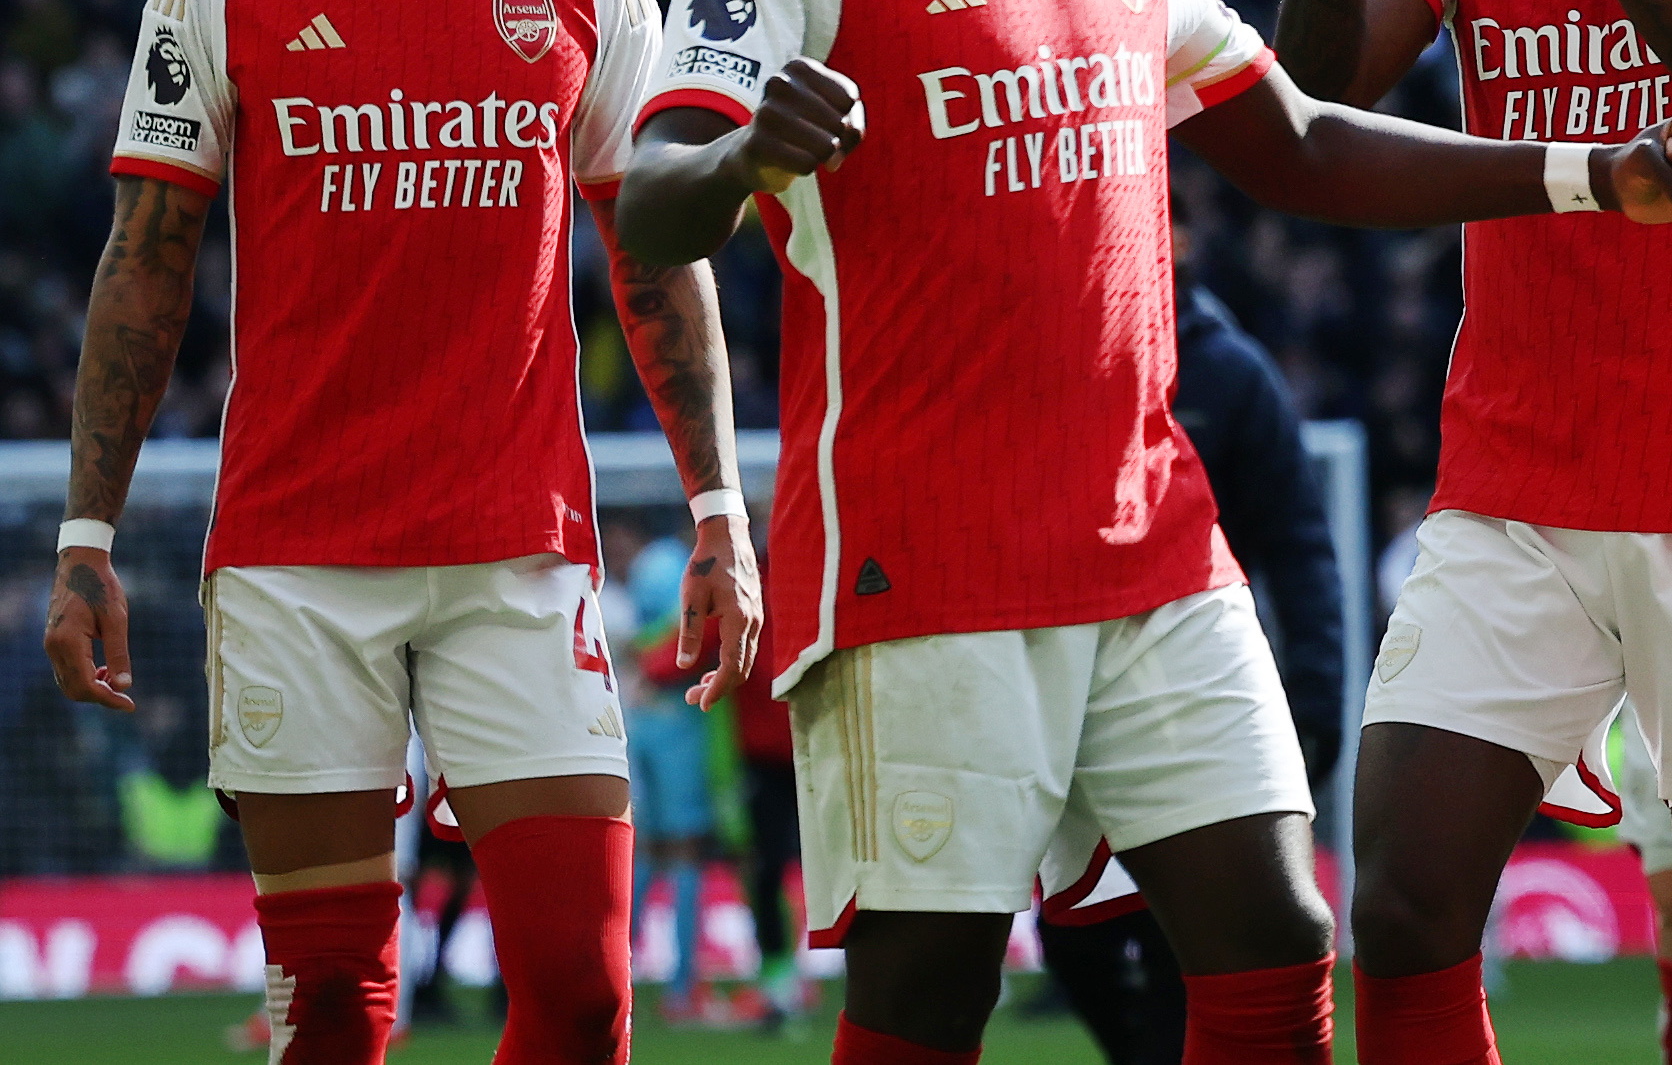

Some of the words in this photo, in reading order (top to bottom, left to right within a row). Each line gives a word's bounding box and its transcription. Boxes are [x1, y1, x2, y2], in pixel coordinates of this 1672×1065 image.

[503, 3, 547, 14] Arsenal
[674, 50, 696, 66] No
[697, 48, 753, 75] room
[1471, 9, 1661, 81] Emira
[917, 40, 1155, 139] Emirates
[1503, 87, 1558, 141] FLY
[134, 112, 152, 129] No
[152, 116, 192, 136] room
[148, 132, 197, 152] racism
[271, 88, 559, 157] Emirates
[985, 132, 1045, 196] FLY
[1058, 119, 1147, 183] BETTER
[321, 163, 381, 213] FLY
[394, 159, 523, 210] BETTER
[572, 596, 614, 694] 4
